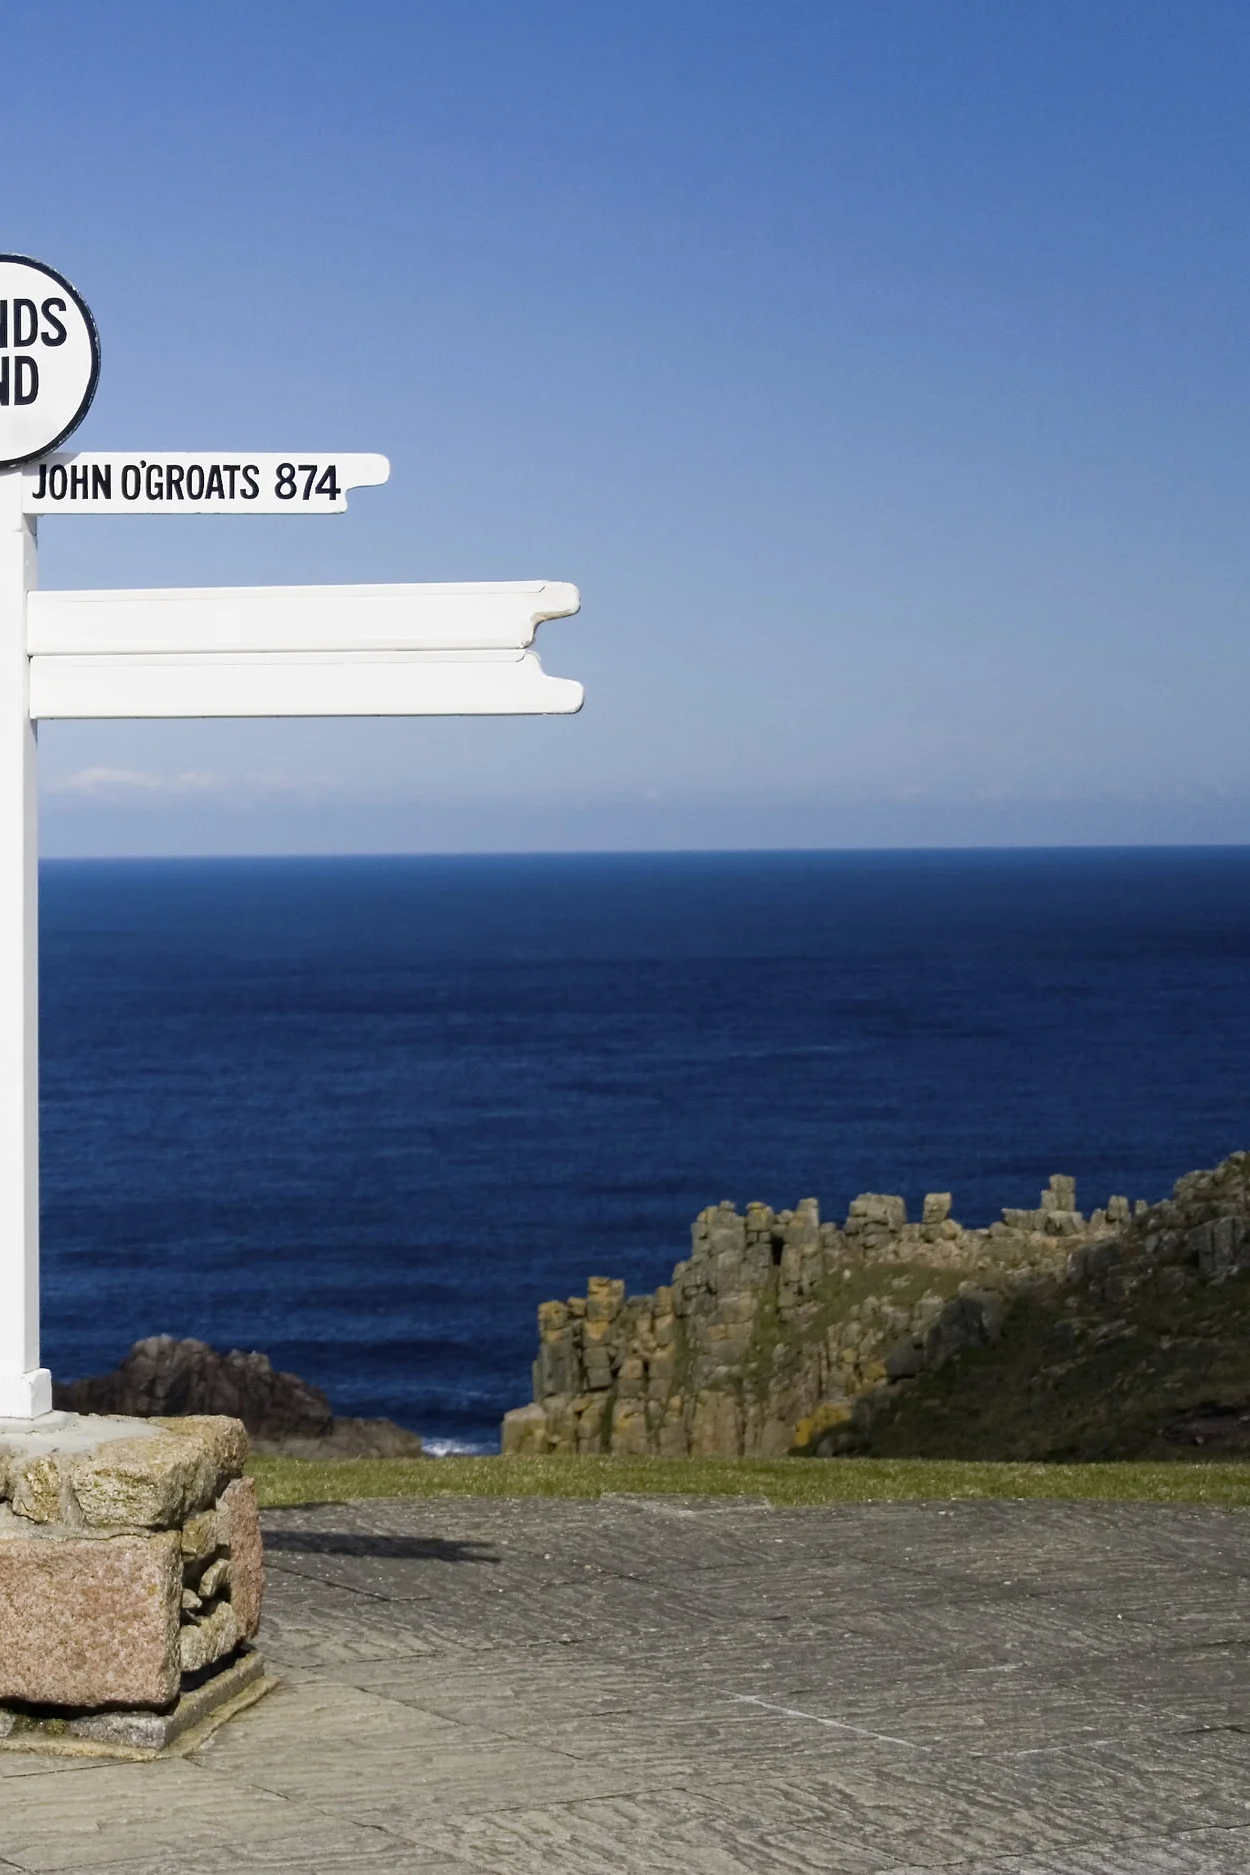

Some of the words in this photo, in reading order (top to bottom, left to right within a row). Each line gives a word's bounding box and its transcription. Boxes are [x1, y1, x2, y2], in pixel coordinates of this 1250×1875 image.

[31, 463, 112, 501] JOHN
[121, 459, 260, 501] O'GROATS
[273, 462, 342, 501] 874
